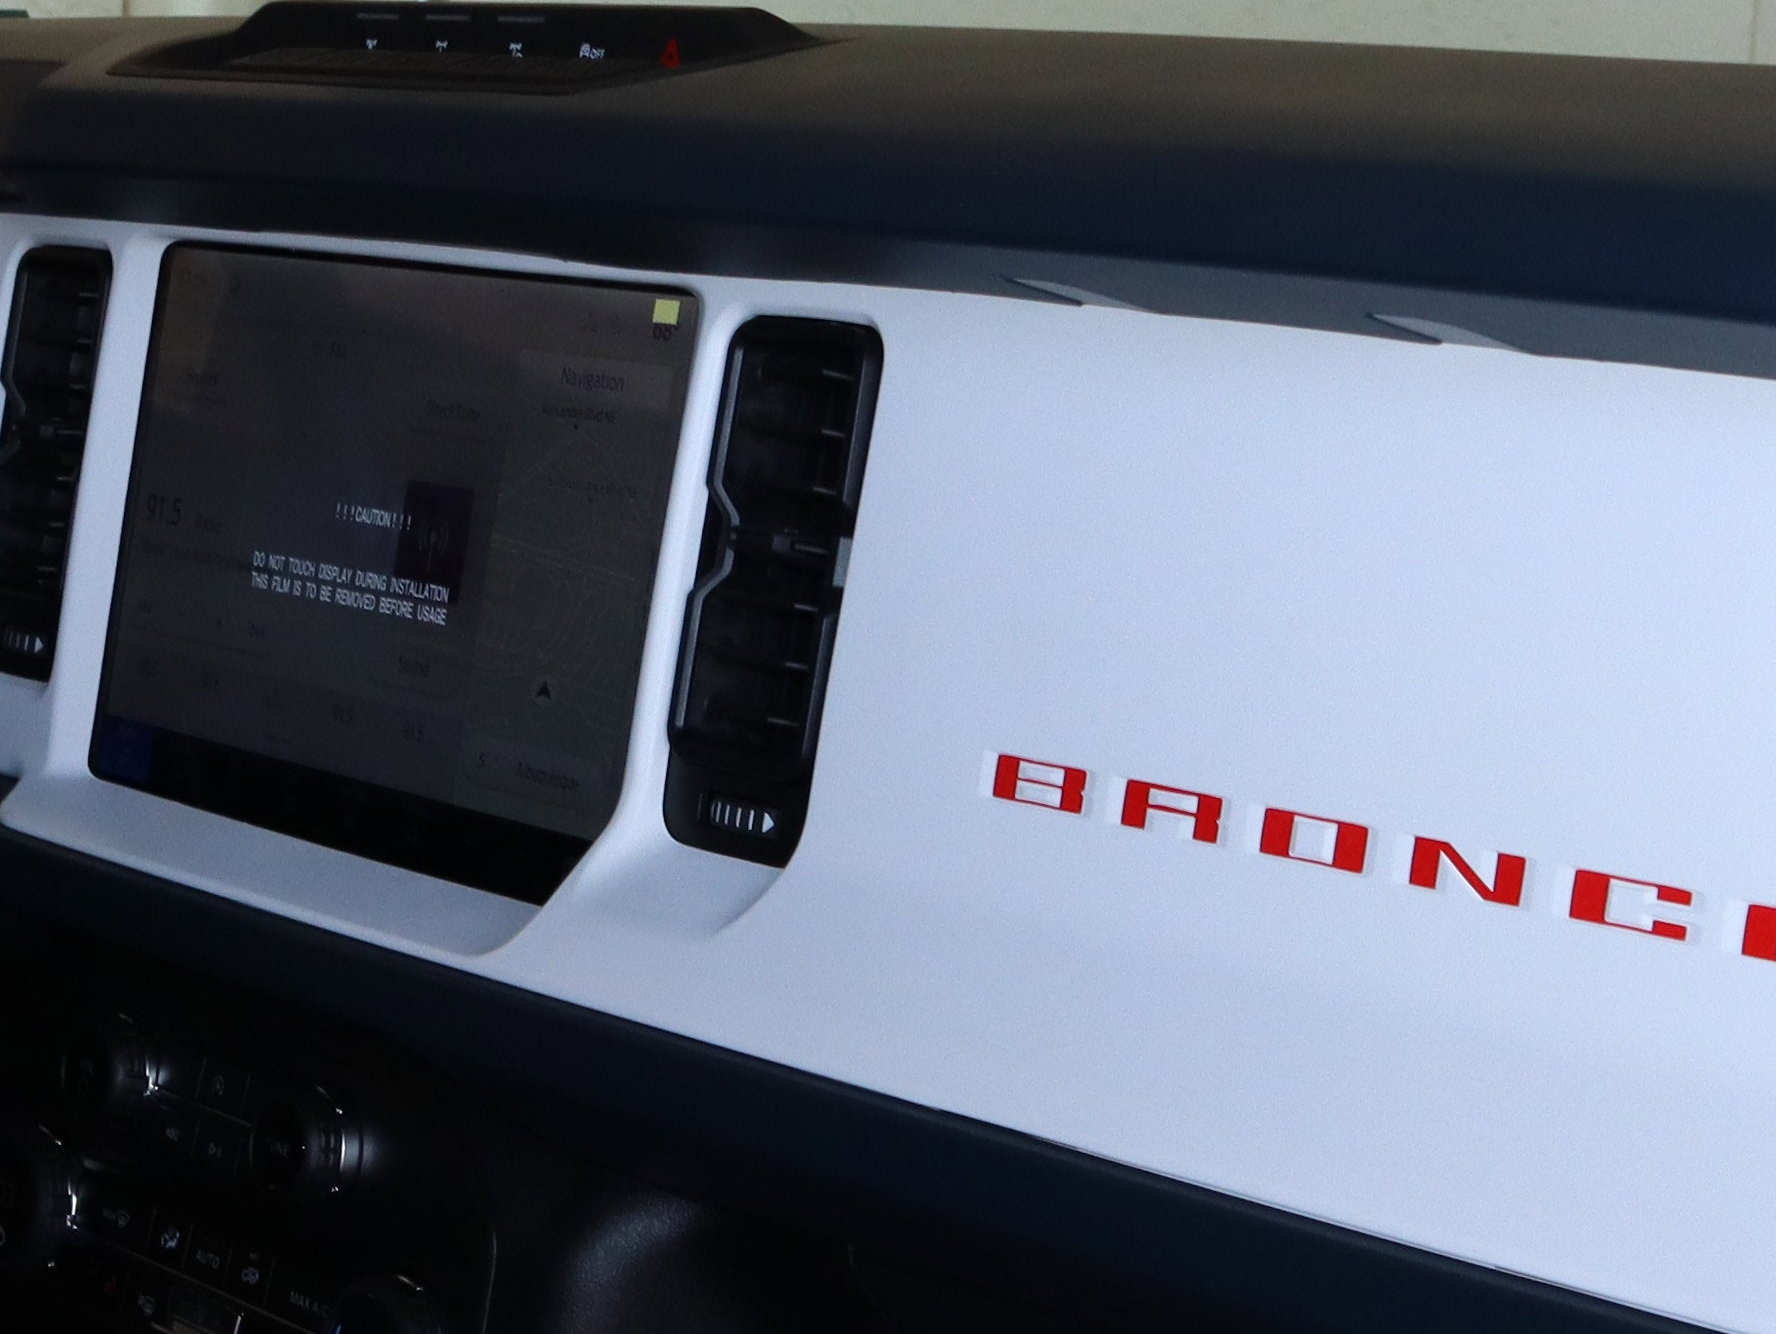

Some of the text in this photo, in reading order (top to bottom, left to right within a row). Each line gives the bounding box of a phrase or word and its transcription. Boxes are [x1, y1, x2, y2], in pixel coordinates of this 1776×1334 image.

[561, 367, 625, 392] Navigation
[146, 494, 183, 526] 91.5
[253, 550, 265, 567] DO
[268, 553, 285, 571] NOT
[288, 556, 315, 577] TOUCH
[318, 562, 353, 584] DISPLAY
[355, 569, 387, 591] DURING
[390, 576, 450, 603] INSTALLATION
[251, 571, 448, 626] THIS FILM IS TO BE REMOVED BEFORE USAGE
[195, 1249, 221, 1269] AUTO
[288, 1290, 310, 1311] MAX
